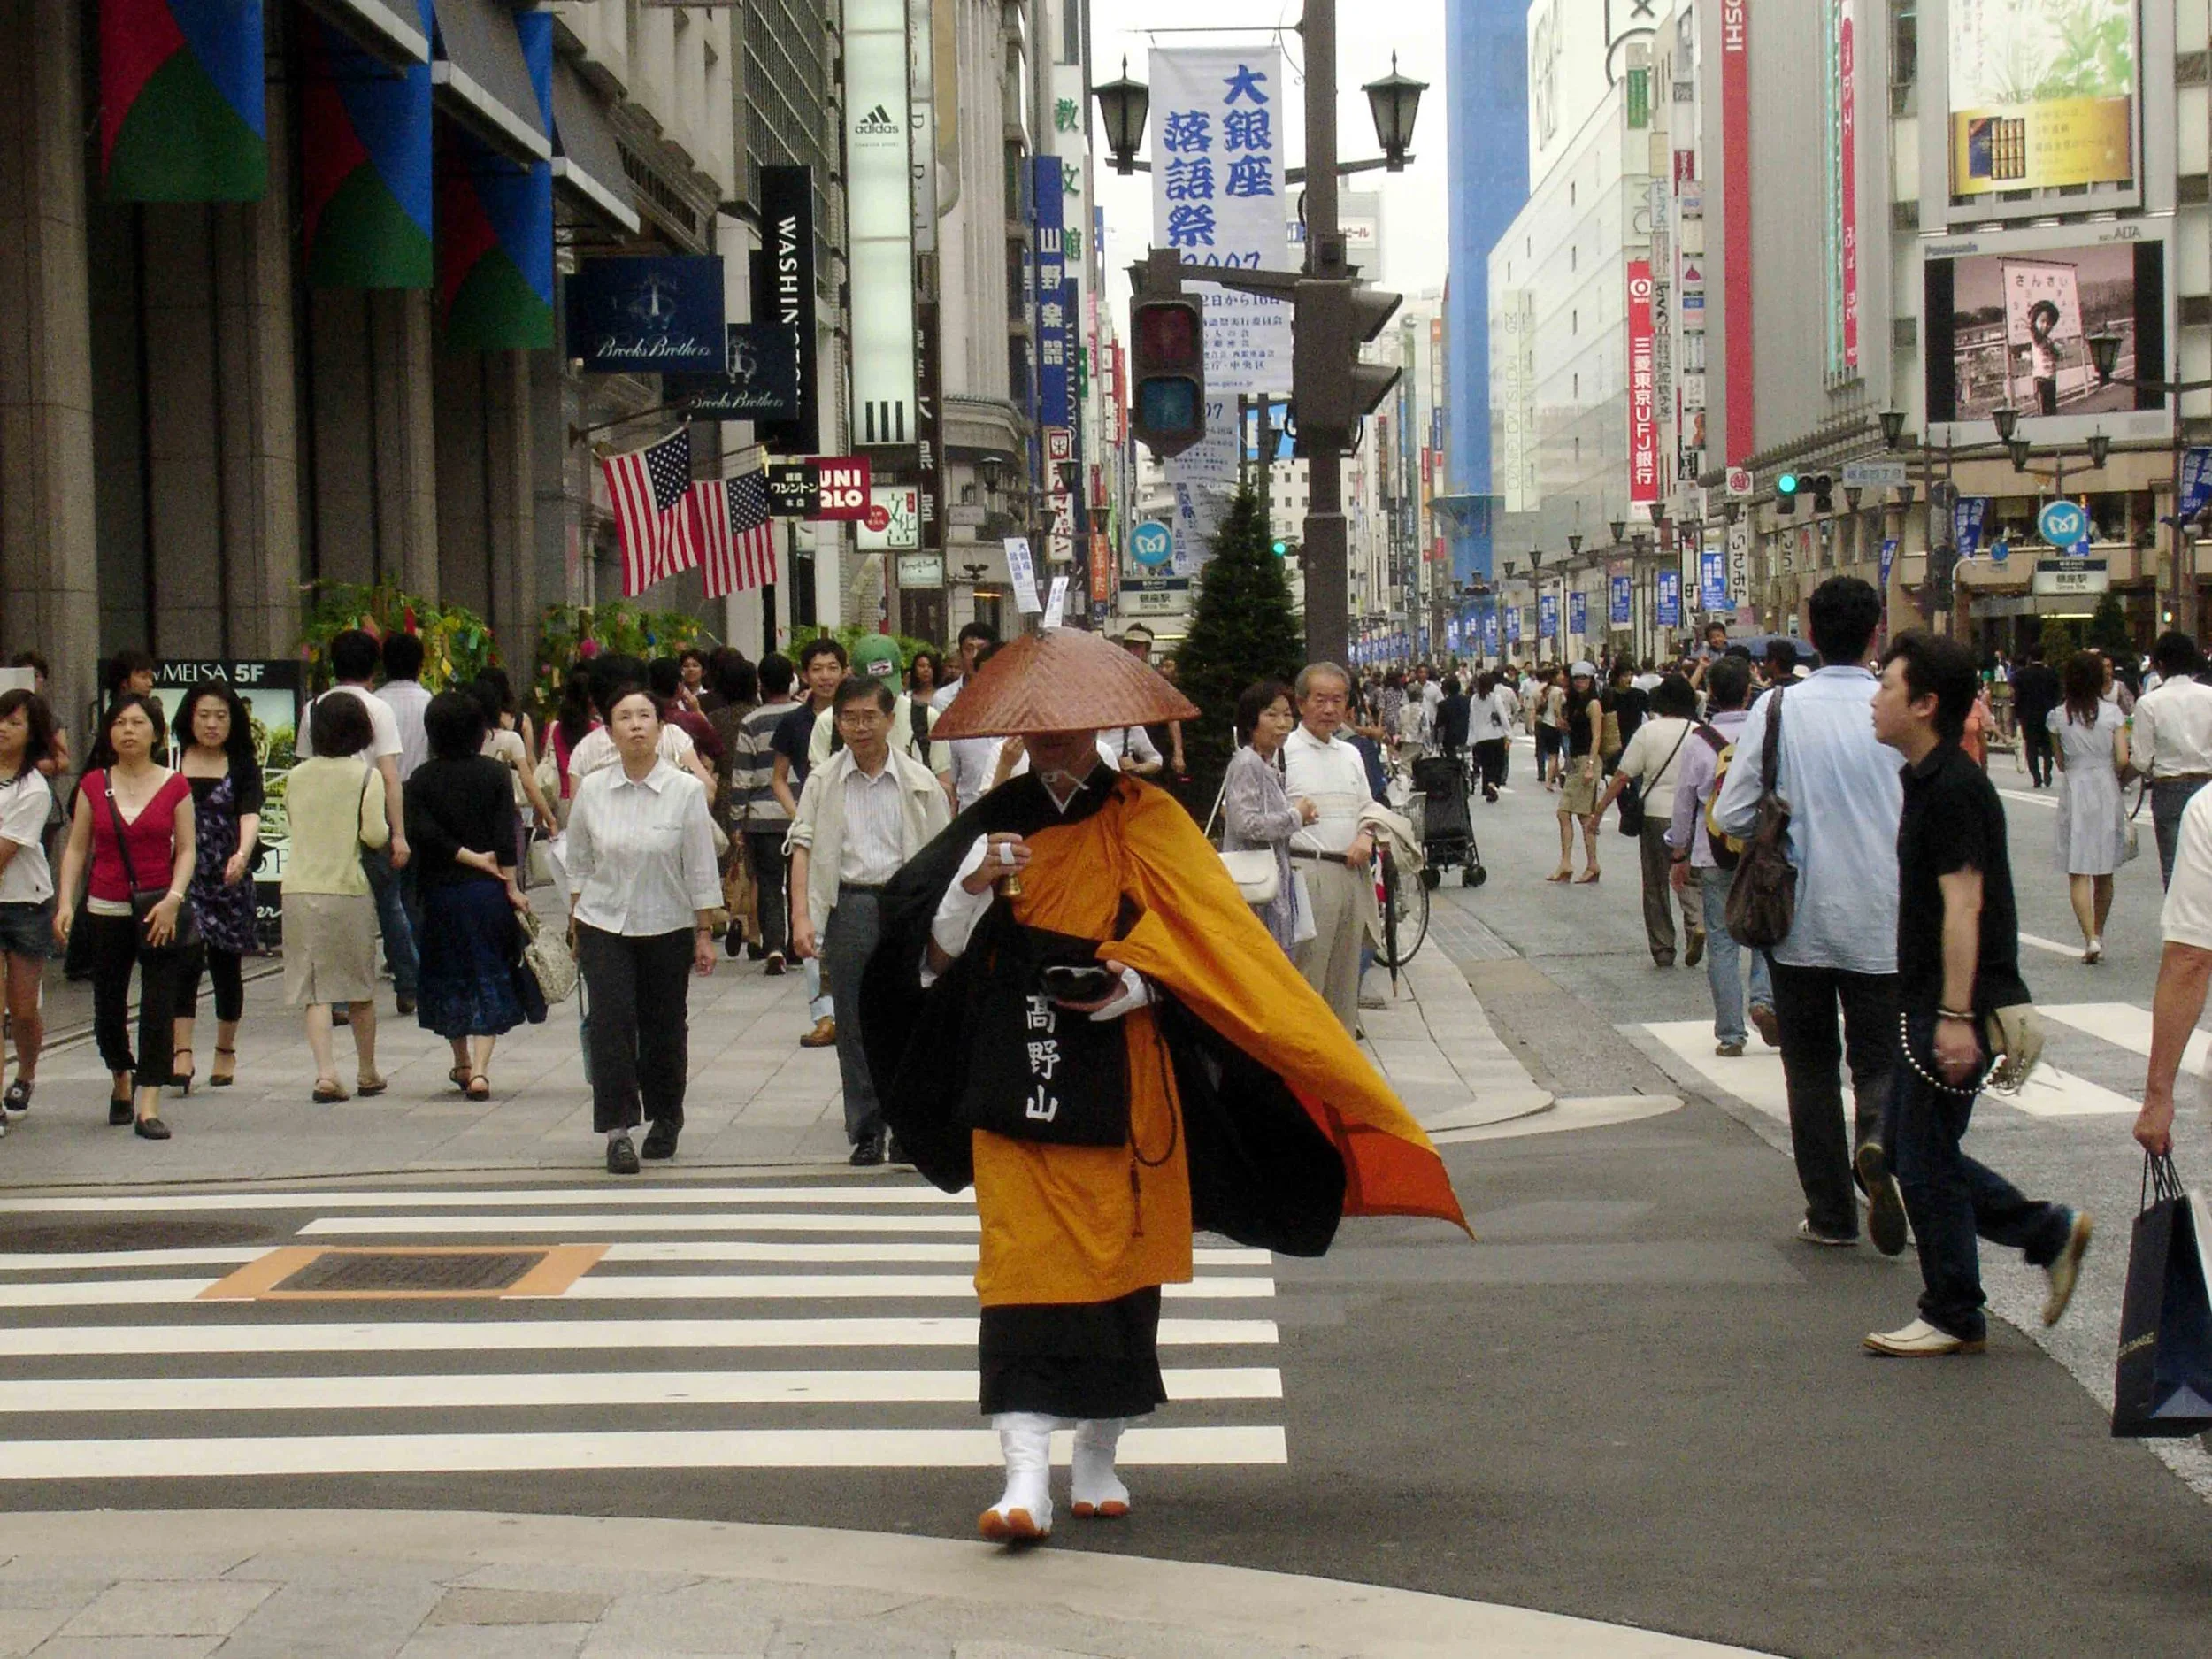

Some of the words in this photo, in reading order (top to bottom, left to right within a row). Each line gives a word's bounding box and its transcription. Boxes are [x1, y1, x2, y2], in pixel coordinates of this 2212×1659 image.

[855, 124, 899, 134] adidas
[1223, 64, 1275, 197] 大銀座
[1163, 110, 1216, 248] 落語祭
[777, 215, 801, 405] WASHIN
[1040, 227, 1064, 365] 山野楽器
[597, 336, 648, 357] Brooks
[649, 335, 711, 357] Brothers
[732, 390, 784, 408] Brothers
[1633, 337, 1654, 486] 三菱東京UFJ銀行
[770, 482, 818, 495] ワシントン
[819, 469, 861, 488] UNI
[163, 664, 228, 683] MELSA
[235, 664, 265, 683] 5F
[1025, 995, 1061, 1123] 高野山
